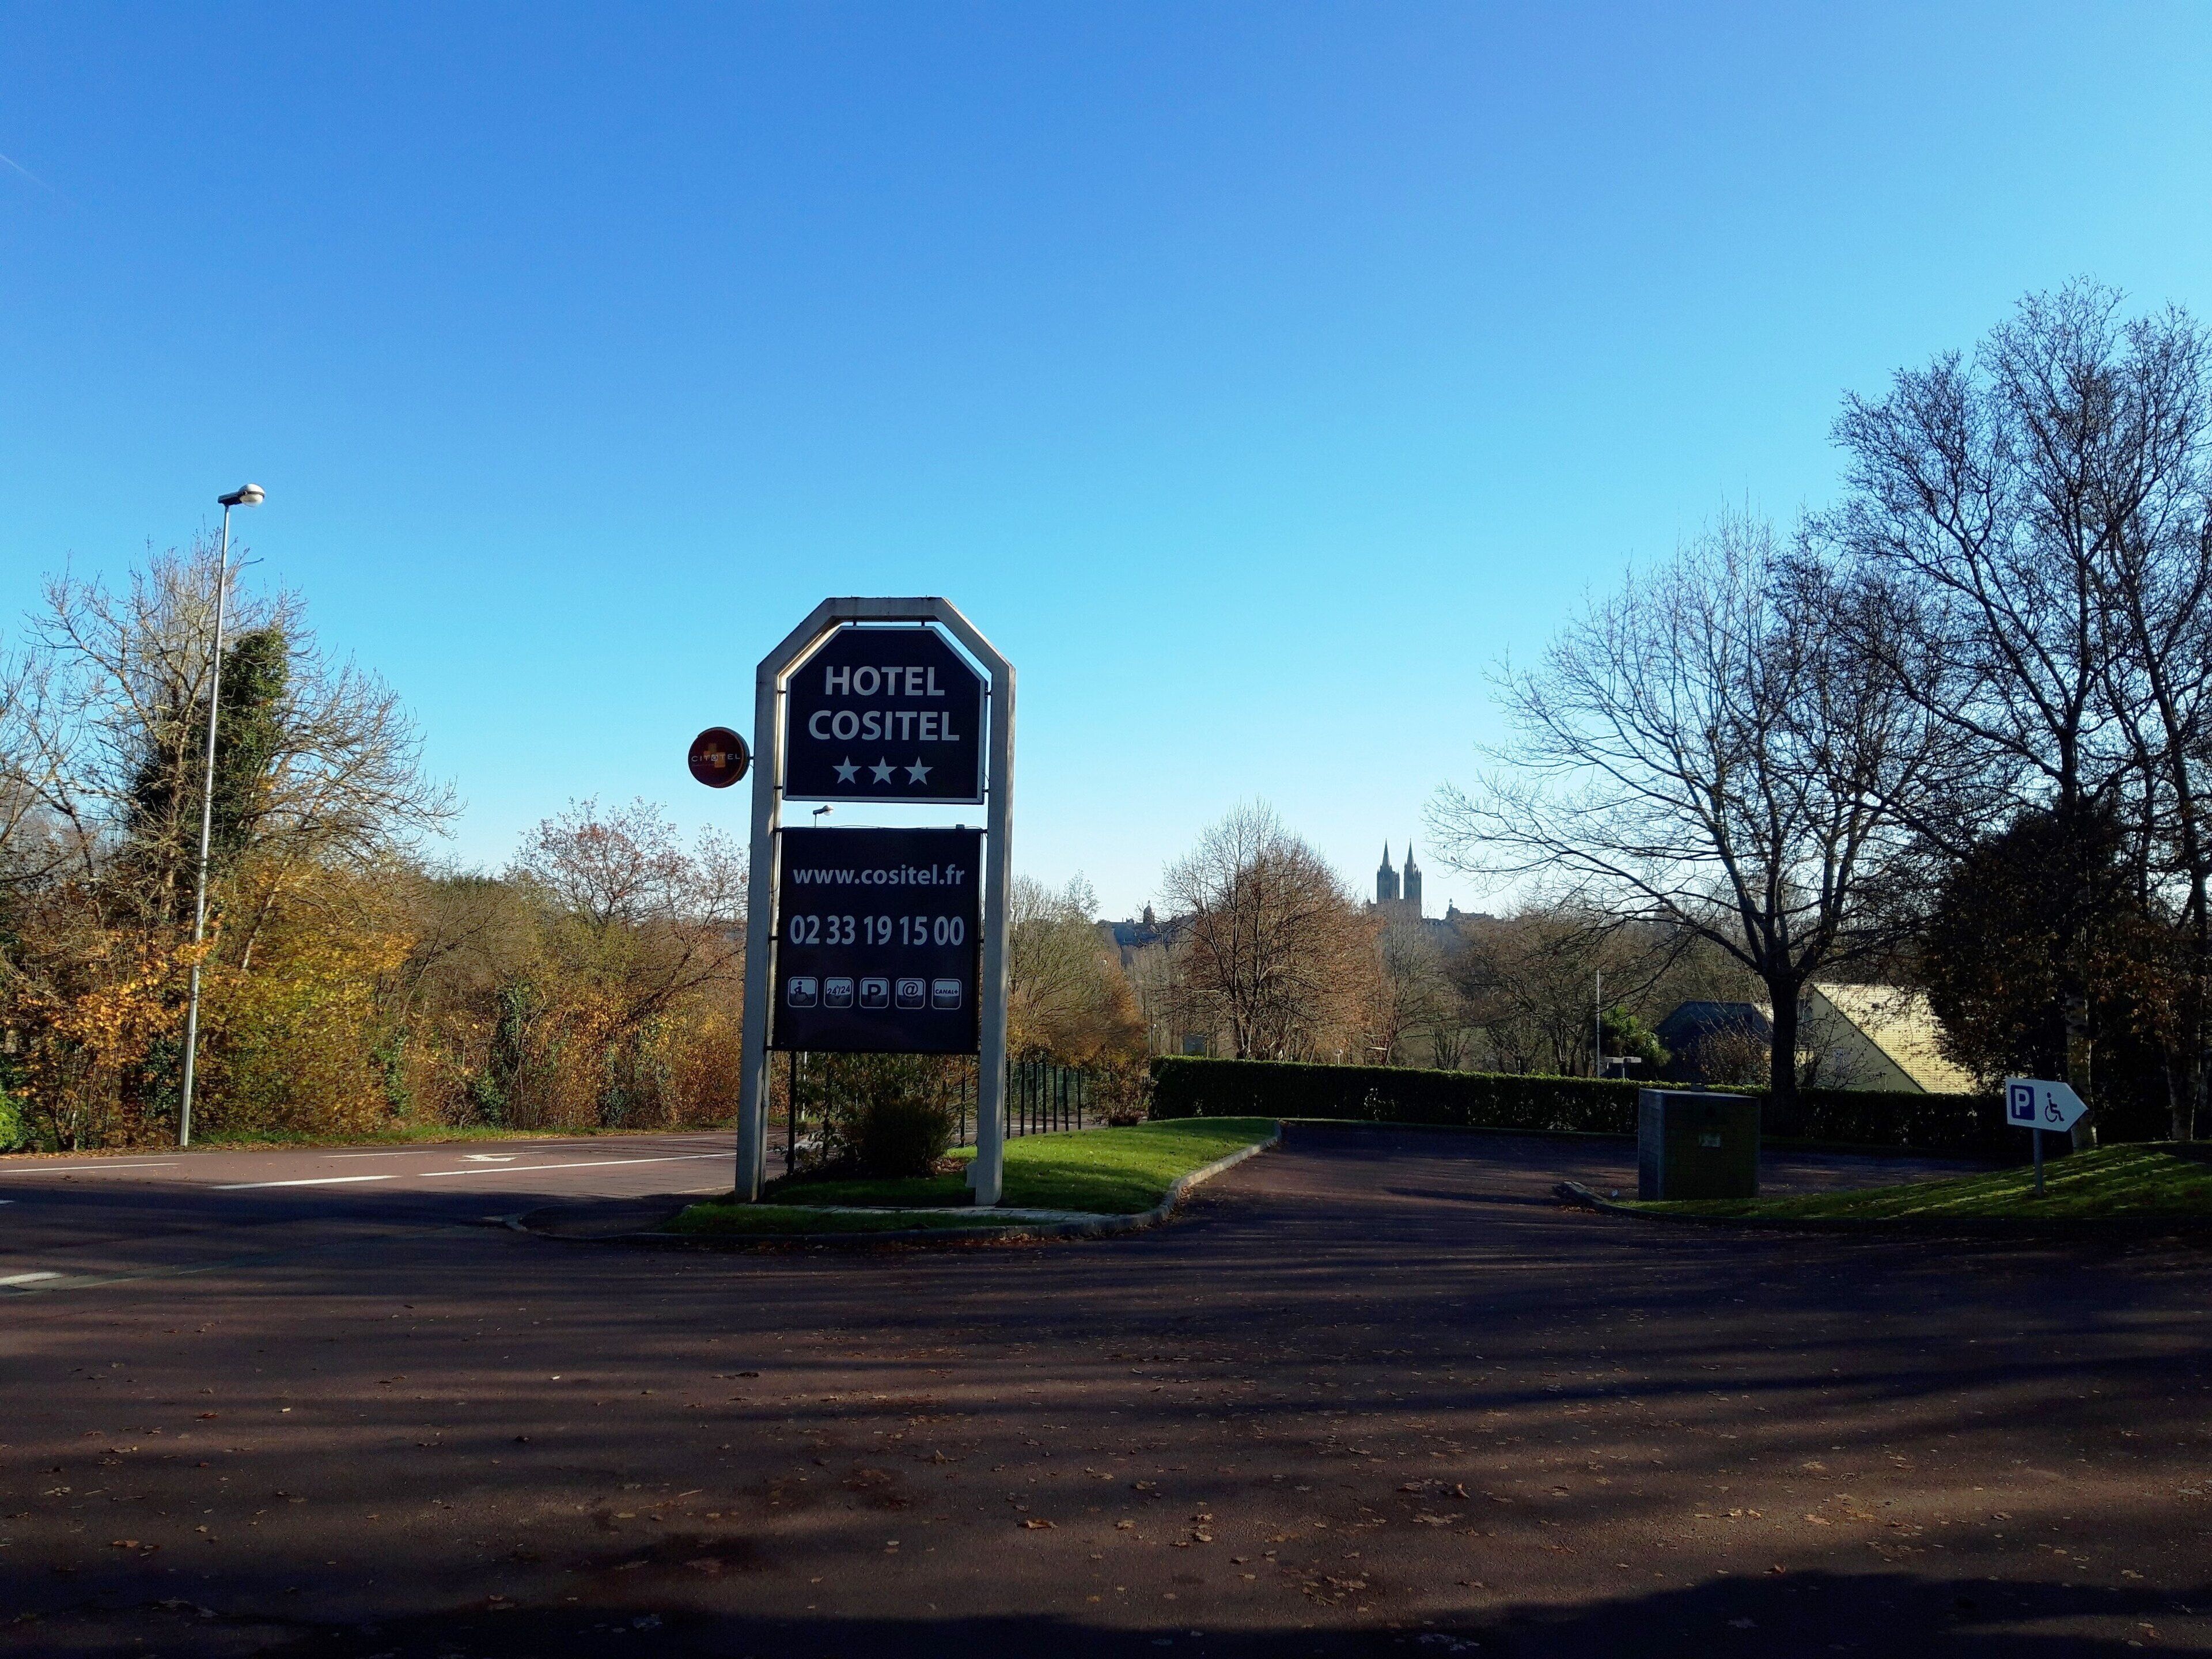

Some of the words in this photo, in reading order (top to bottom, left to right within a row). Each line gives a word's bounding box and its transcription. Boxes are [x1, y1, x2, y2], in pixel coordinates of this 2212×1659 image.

[825, 666, 945, 696] HOTEL
[809, 710, 959, 741] COSITEL
[691, 753, 741, 762] CITOTEL
[793, 863, 965, 885] www.cositel.fr
[867, 983, 882, 1001] P
[2014, 1088, 2030, 1116] P
